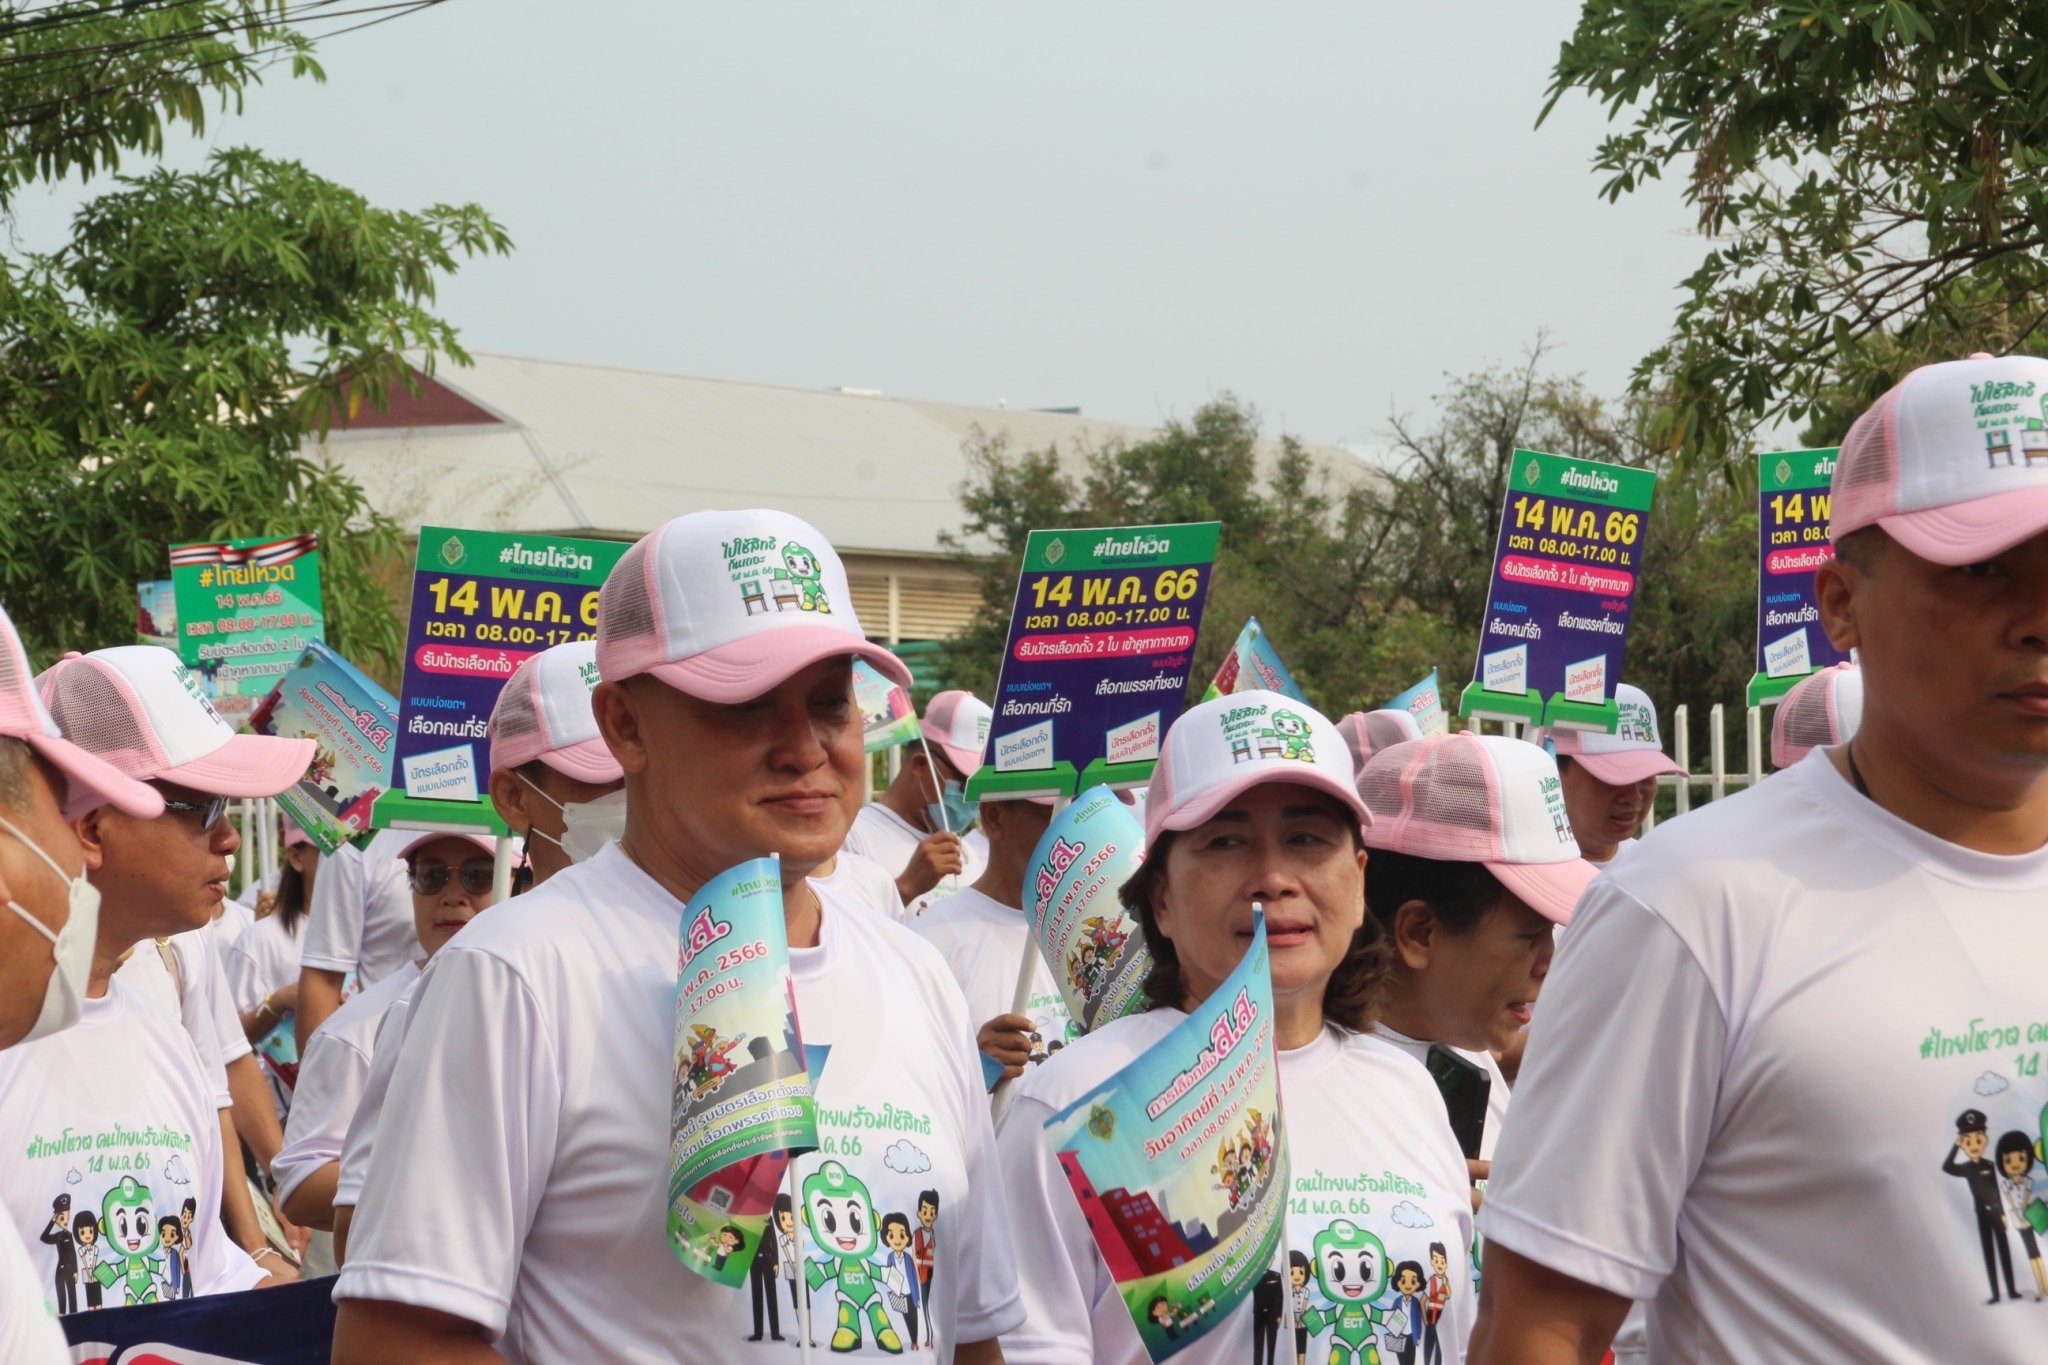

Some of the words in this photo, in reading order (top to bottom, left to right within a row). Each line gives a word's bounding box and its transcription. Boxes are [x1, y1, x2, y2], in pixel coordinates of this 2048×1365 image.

[1970, 380, 2036, 404] ไปใช้สิทธิ
[1560, 466, 1619, 494] #ไทยโหวต
[1513, 496, 1546, 531] 14
[1551, 505, 1600, 541] พ.ค.
[1604, 511, 1639, 546] 66
[1770, 493, 1805, 526] 14
[721, 536, 777, 559] ไปใช้สิทธิ
[1093, 534, 1170, 557] #ไทยโหวต
[1508, 534, 1534, 551] เวลา
[1539, 537, 1617, 564] 08.00-17.00
[1620, 551, 1632, 566] น.
[1771, 531, 1798, 545] เวลา
[499, 542, 593, 571] #ไทยโหวต
[1771, 548, 1828, 570] รับบัตรเลือกตั้ง
[1031, 575, 1073, 609] 14
[1082, 575, 1147, 607] พ.ค.
[1154, 567, 1200, 603] 66
[1503, 561, 1559, 583] รับบัตรเลือกตั้ง
[1560, 571, 1567, 584] 2
[1579, 570, 1630, 593] เข้าคูหากากบาท
[215, 594, 235, 609] 14
[429, 577, 479, 616] 14
[490, 586, 572, 625] พ.ค.
[580, 590, 600, 627] 6
[1766, 602, 1819, 627] เลือกคนที่รัก
[186, 621, 214, 636] เวลา
[217, 613, 297, 633] 08.00-17.00
[301, 614, 315, 626] น.
[425, 620, 466, 639] เวลา
[1025, 615, 1059, 629] เวลา
[1066, 606, 1170, 628] 08.00-17.00
[1176, 606, 1191, 620] น.
[1489, 617, 1542, 640] เลือกคนที่รัก
[1558, 610, 1625, 636] เลือกพรรคที่ชอบ
[198, 637, 278, 659] รับบัตรเลือกตั้ง
[281, 639, 290, 651] 2
[1019, 635, 1094, 657] รับบัตรเลือกตั้ง
[1096, 640, 1104, 653] 2
[1121, 636, 1189, 655] เข้าคูหากากบาท
[1769, 637, 1805, 664] บัตรเลือกตั้ง
[422, 650, 512, 673] รับบัตรเลือกตั้ง
[1487, 653, 1524, 675] บัตรเลือกตั้ง
[1569, 664, 1603, 685] บัตรเลือกตั้ง
[1095, 669, 1184, 696] เลือกพรรคที่ชอบ
[1002, 693, 1072, 717] เลือกคนที่รัก
[1220, 704, 1268, 726] ไปใช้สิทธิ
[355, 711, 393, 752] ส.ส.
[1000, 729, 1049, 757] บัตรเลือกตั้ง
[1111, 721, 1156, 750] บัตรเลือกตั้ง
[337, 725, 348, 738] 14
[363, 752, 383, 774] 2566
[410, 755, 469, 781] บัตรเลือกตั้ง
[1036, 836, 1083, 901] ส.ส.
[1053, 906, 1066, 926] 14
[1062, 876, 1087, 908] พ.ค.
[1082, 842, 1118, 876] 2566
[1074, 883, 1099, 920] 17.00
[1098, 873, 1110, 887] น.
[683, 968, 715, 999] พ.ค.
[716, 941, 768, 972] 2566
[689, 983, 726, 1014] 17.00
[727, 976, 744, 991] น.
[1148, 1047, 1219, 1119] การเลือกตั้ง
[1210, 985, 1259, 1057] ส.ส.
[1919, 1018, 2021, 1060] #ไทยโหวต
[2014, 1051, 2041, 1079] 14
[697, 1080, 811, 1128] รับบัตรเลือกตั้งสอง
[1144, 1083, 1220, 1161] วันอาทิตย์ที่
[1219, 1073, 1236, 1098] 14
[1234, 1052, 1256, 1080] พ.ค.
[699, 1104, 803, 1147] เลือกพรรคที่ชอบ
[814, 1101, 932, 1136] ไทยพร้อมใช้สิทธิ
[26, 1127, 92, 1160] #ไทยโหวต
[817, 1135, 838, 1155] .ค.
[840, 1134, 863, 1157] 66
[1180, 1137, 1206, 1161] เวลา
[1203, 1111, 1231, 1141] 08.00
[87, 1154, 104, 1174] 14
[108, 1153, 132, 1172] พ.ค.
[134, 1151, 151, 1170] 66
[1295, 1169, 1428, 1199] คนไทยพร้อมใช้สิทธิ
[1288, 1198, 1307, 1215] 14
[1312, 1198, 1346, 1215] พ.ค.
[1349, 1198, 1371, 1215] 66
[129, 1270, 146, 1280] ECT
[843, 1272, 866, 1285] ECT
[1343, 1317, 1365, 1329] ECT
